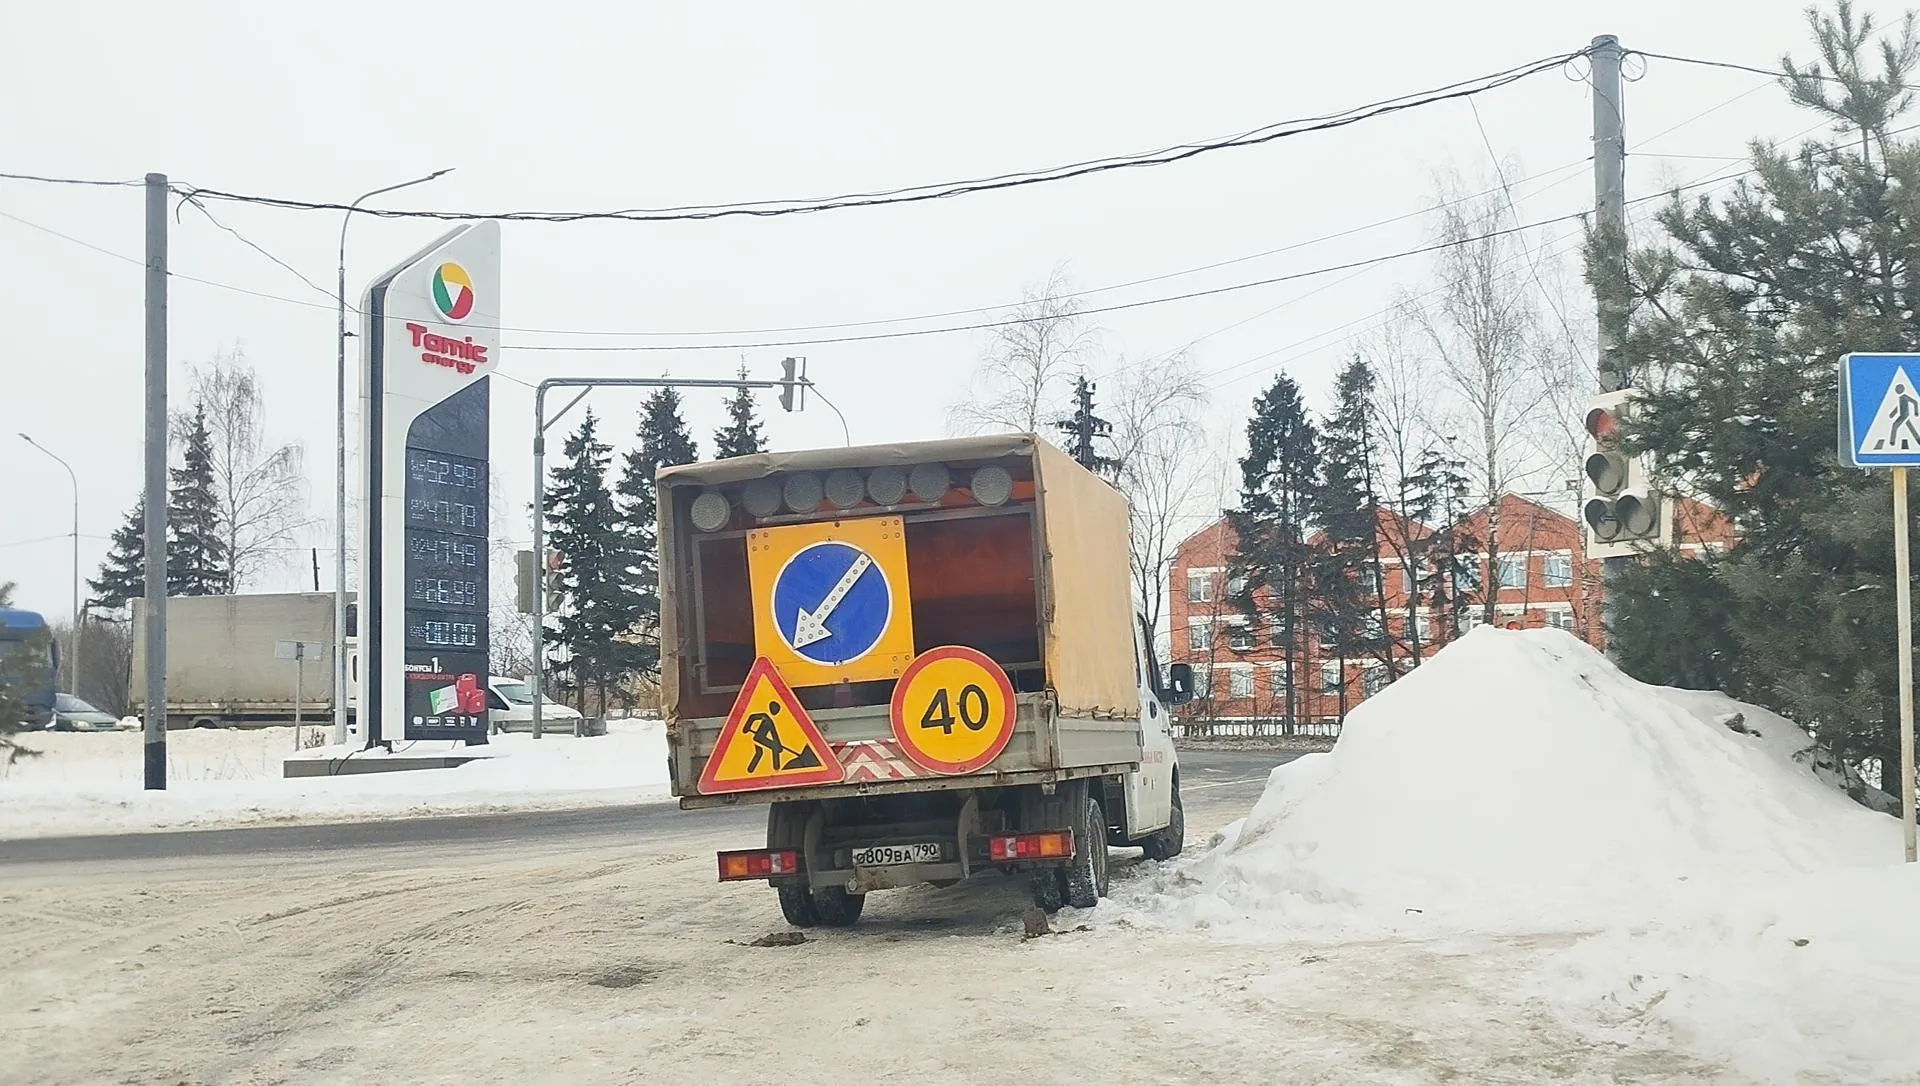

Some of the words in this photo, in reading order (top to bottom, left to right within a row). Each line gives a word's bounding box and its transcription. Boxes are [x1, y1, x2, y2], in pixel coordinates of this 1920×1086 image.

[406, 322, 488, 363] Tamic
[421, 352, 476, 374] energy
[920, 684, 989, 734] 40
[914, 844, 937, 857] 790
